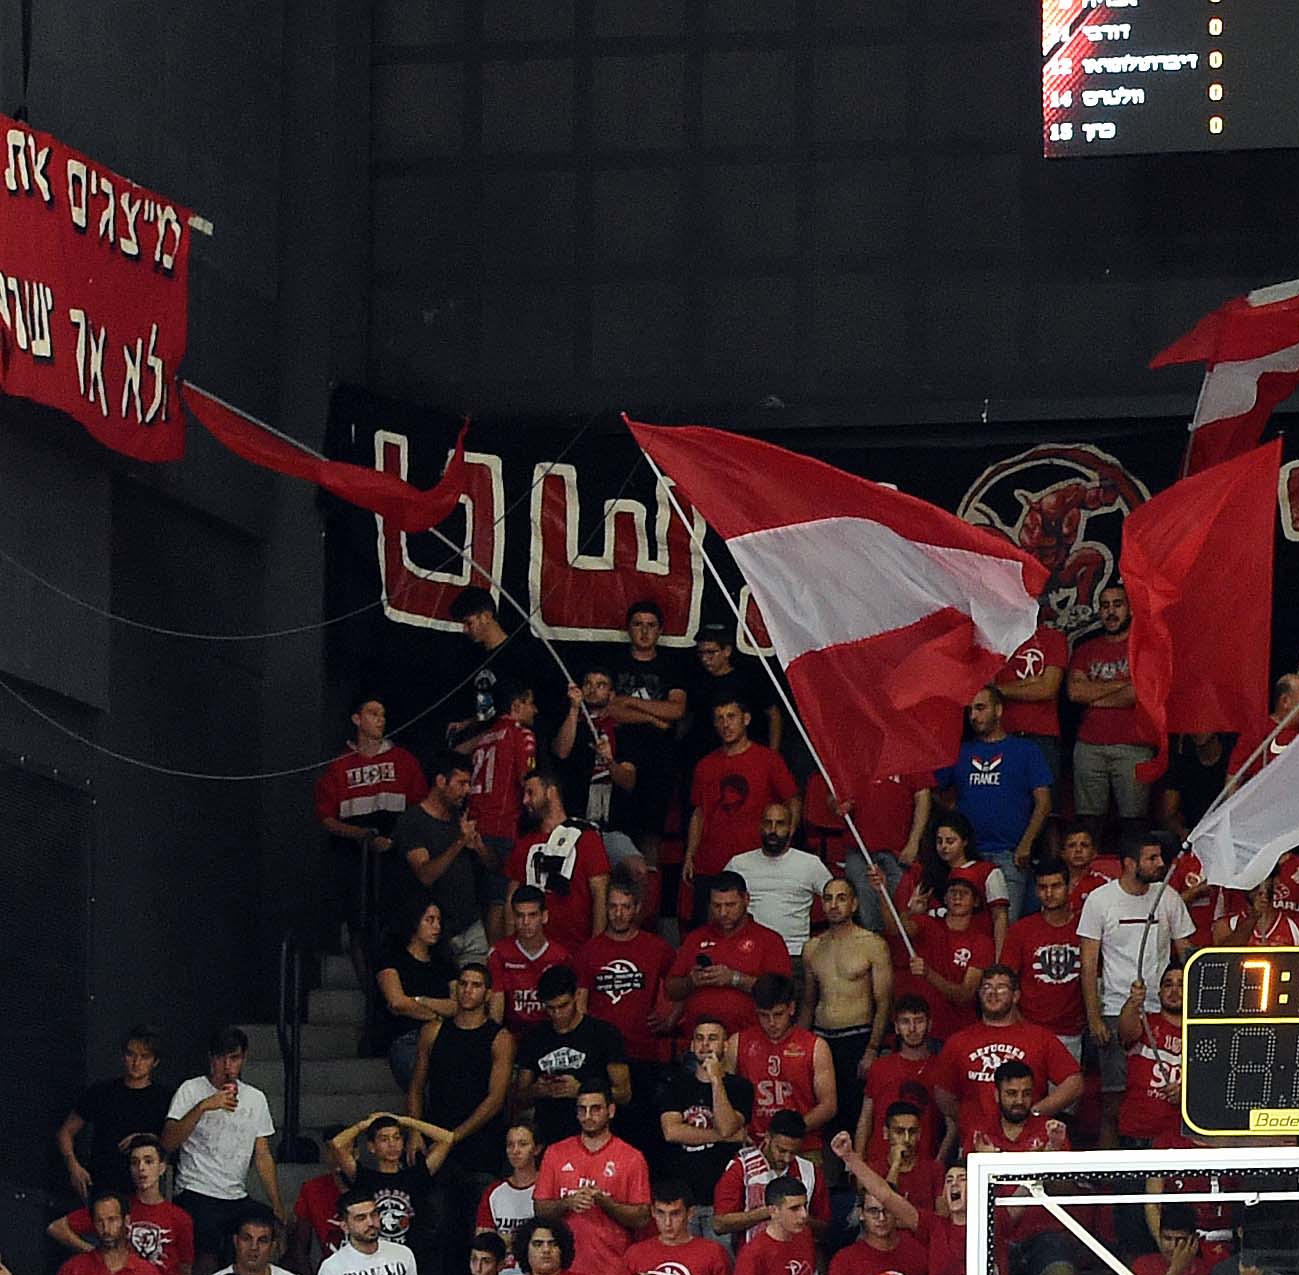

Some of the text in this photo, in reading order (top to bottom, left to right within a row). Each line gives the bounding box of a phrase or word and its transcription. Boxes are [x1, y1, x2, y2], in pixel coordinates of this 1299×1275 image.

[1208, 18, 1223, 35] 0
[1208, 51, 1223, 68] 0
[1208, 84, 1223, 100] 0
[1209, 117, 1223, 134] 0
[5, 130, 50, 201] את
[472, 746, 497, 795] 21
[968, 770, 1001, 786] FRANCE
[967, 1043, 1027, 1062] REFUGEES
[765, 1055, 779, 1078] 3
[755, 1081, 791, 1109] SP
